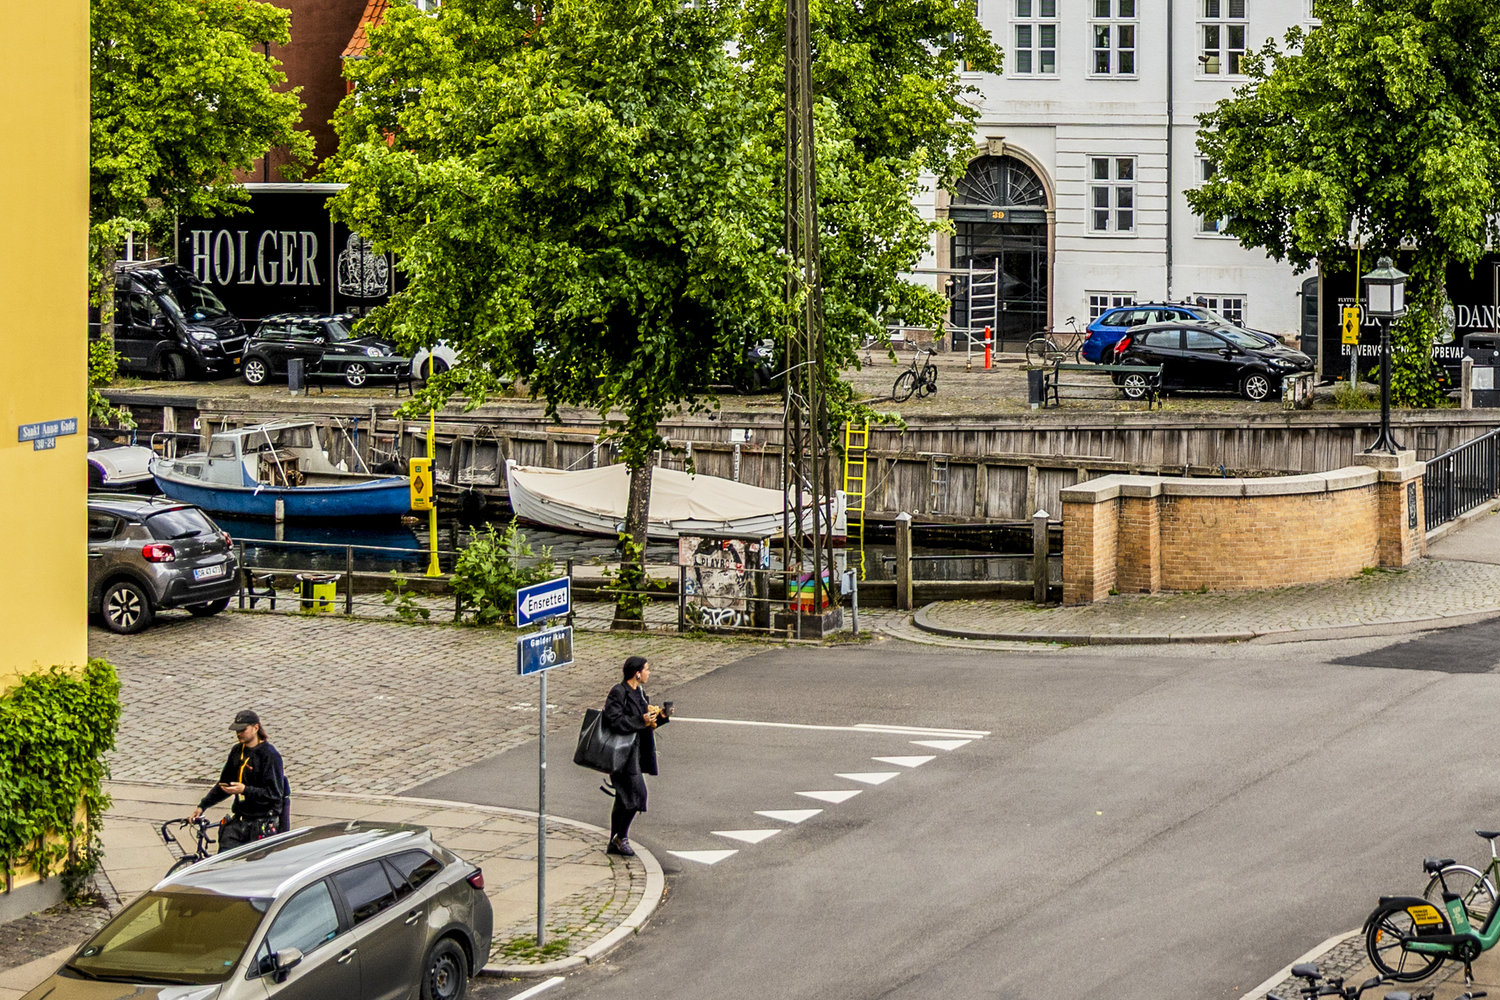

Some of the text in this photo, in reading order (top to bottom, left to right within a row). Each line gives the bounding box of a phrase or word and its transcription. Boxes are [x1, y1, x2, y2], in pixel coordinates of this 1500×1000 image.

[992, 210, 1005, 219] 39
[190, 229, 321, 286] HOLGER
[22, 419, 76, 438] Sankt Annæ Gade
[528, 592, 566, 612] Ensrettet
[530, 634, 552, 647] Gælder
